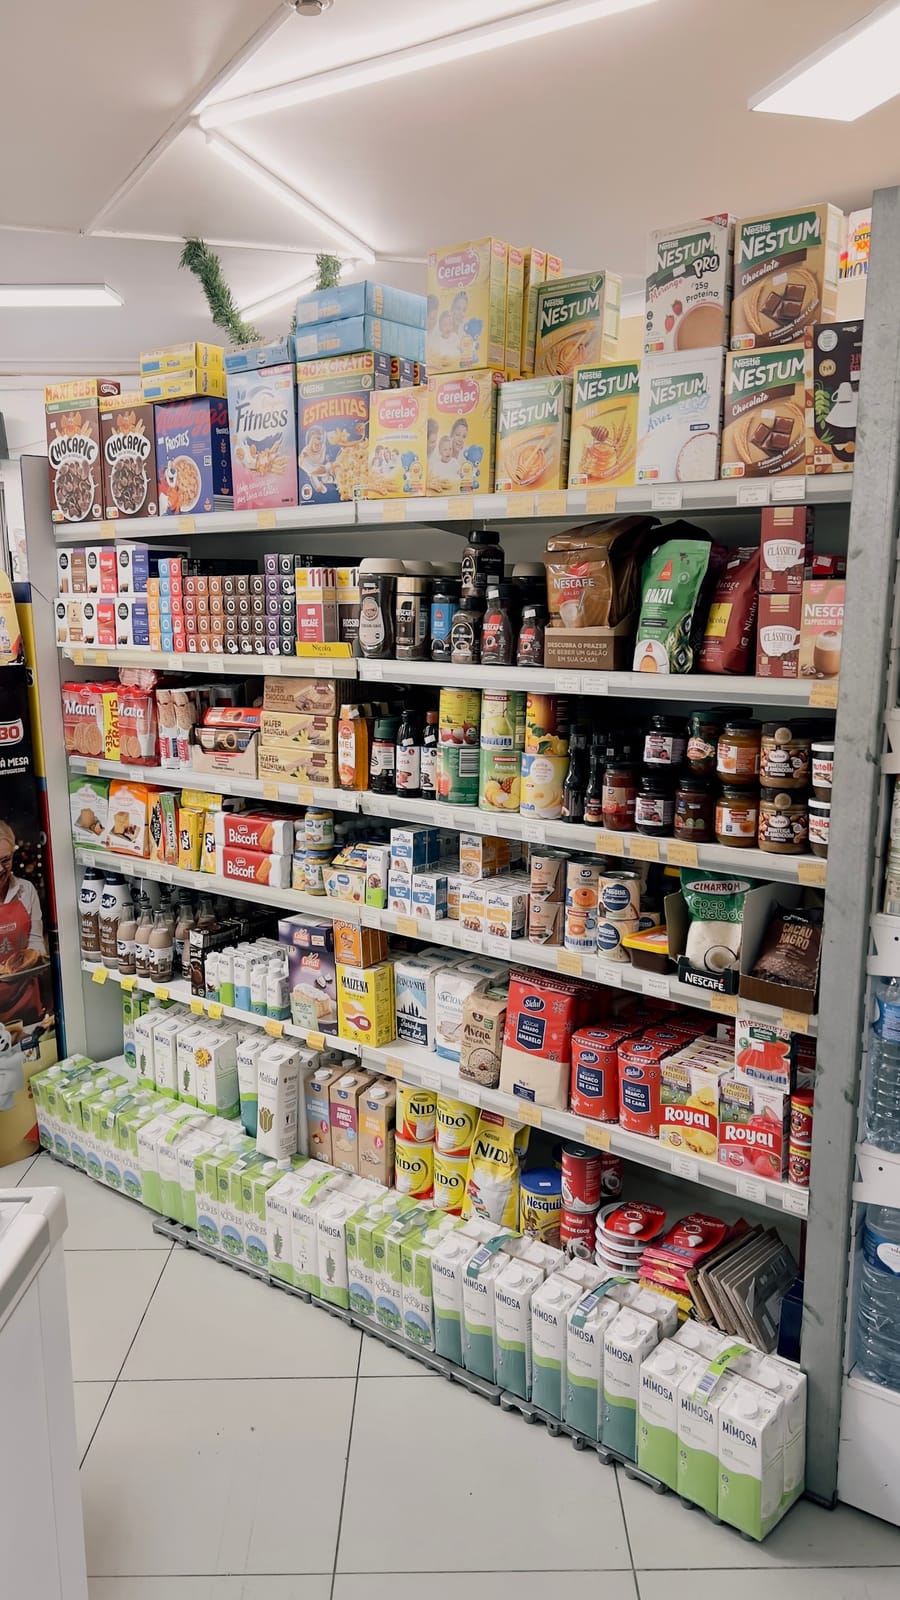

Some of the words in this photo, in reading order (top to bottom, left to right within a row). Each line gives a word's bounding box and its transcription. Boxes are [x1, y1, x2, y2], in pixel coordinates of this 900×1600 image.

[744, 222, 771, 236] Nestlé
[854, 232, 871, 242] EXTR
[737, 216, 821, 266] NESTUM
[656, 233, 715, 273] NESTUM
[438, 262, 476, 279] Cerelac
[692, 256, 719, 278] PRO
[741, 260, 780, 286] Chocolate
[695, 282, 709, 290] 25g
[541, 294, 600, 331] NESTUM
[734, 357, 760, 369] Nestlé
[729, 359, 806, 395] NESTUM
[438, 388, 476, 404] Cerelac
[575, 371, 640, 404] NESTUM
[650, 376, 709, 406] NESTUM
[303, 397, 367, 427] ESTRELITAS
[380, 406, 416, 420] Cerelac
[732, 393, 768, 416] Chocolate
[235, 402, 288, 432] Fitness
[500, 400, 559, 432] NESTUM
[51, 438, 95, 465] CHOCAPIC
[107, 435, 148, 461] CHOCAPIC
[309, 568, 322, 587] 11
[323, 568, 336, 587] 11
[644, 588, 675, 605] BRAZIL
[583, 642, 608, 650] PRAZER
[65, 699, 97, 716] Maria
[7, 756, 29, 766] MESA
[814, 763, 833, 771] utell
[809, 819, 830, 828] utella
[228, 828, 259, 845] Biscoff
[227, 861, 256, 879] Biscoff
[693, 896, 725, 910] Coco
[782, 923, 813, 939] CACAU
[341, 975, 369, 994] MAIZENA
[409, 1102, 435, 1115] NID
[665, 1107, 710, 1128] Royal
[725, 1125, 774, 1148] Royal
[526, 1195, 562, 1213] Nesqui
[318, 1223, 341, 1239] MIMOSA
[432, 1263, 456, 1280] MIMOSA
[463, 1278, 488, 1295] MIMOSA
[495, 1291, 521, 1310] MIMOSA
[533, 1307, 558, 1326] MIMOSA
[567, 1324, 595, 1345] MIMOSA
[603, 1344, 633, 1364] MIMOSA
[642, 1377, 674, 1402] MIMOSA
[681, 1398, 714, 1425] MIMOSA
[722, 1420, 758, 1449] MIMOSA
